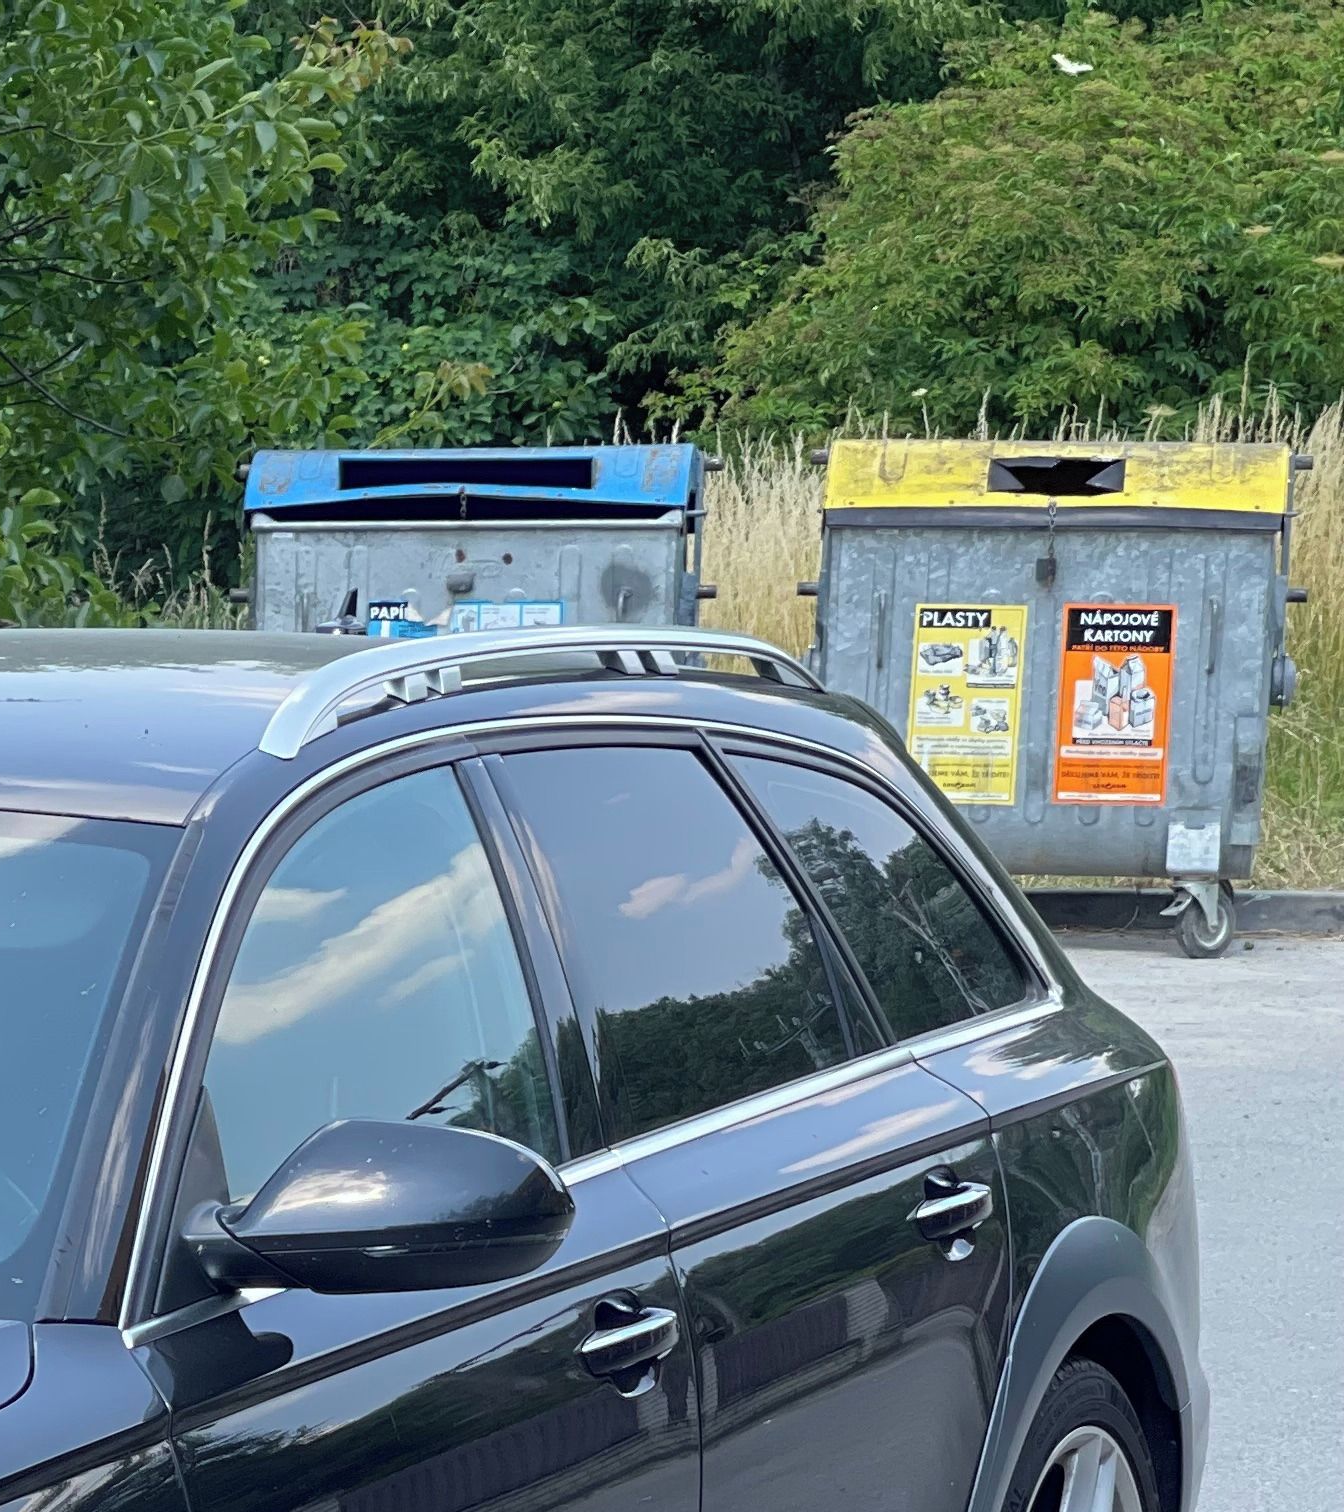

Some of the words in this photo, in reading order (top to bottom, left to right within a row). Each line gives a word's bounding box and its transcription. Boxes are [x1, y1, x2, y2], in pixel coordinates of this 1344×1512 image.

[370, 603, 408, 620] PAPÍ
[922, 611, 988, 626] PLASTY
[1080, 610, 1158, 626] NÁPOJOVÉ
[1084, 628, 1153, 642] KARTONY
